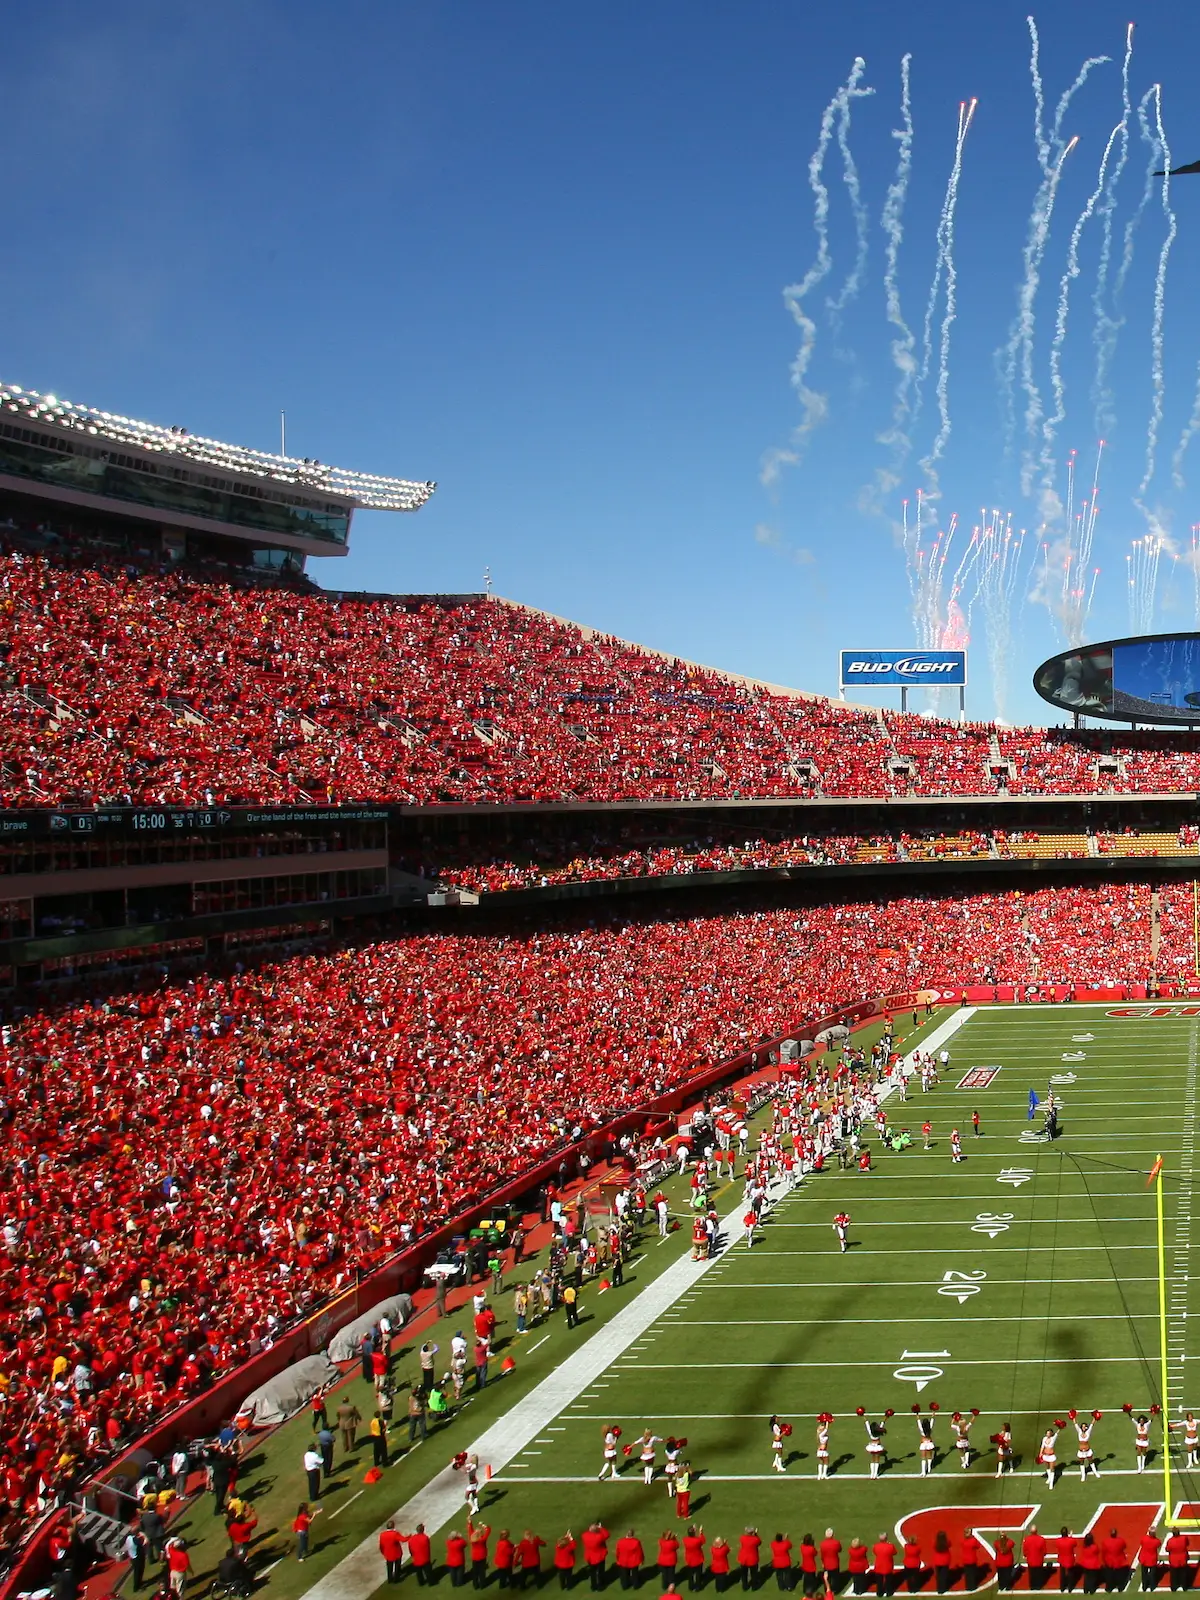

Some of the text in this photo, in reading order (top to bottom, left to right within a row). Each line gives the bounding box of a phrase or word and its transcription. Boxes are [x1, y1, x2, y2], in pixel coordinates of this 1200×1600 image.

[847, 662, 959, 673] BUD LIGHT
[132, 814, 165, 829] 15:00
[205, 814, 211, 824] 0
[294, 812, 304, 820] the
[330, 811, 339, 819] the
[340, 811, 356, 819] home
[374, 810, 388, 818] brave
[4, 821, 28, 830] brave
[79, 818, 85, 828] 0
[886, 993, 918, 1008] CHIEFS
[996, 1167, 1034, 1183] 40
[971, 1213, 1014, 1232] 30
[938, 1270, 987, 1296] 20
[893, 1350, 951, 1381] 10
